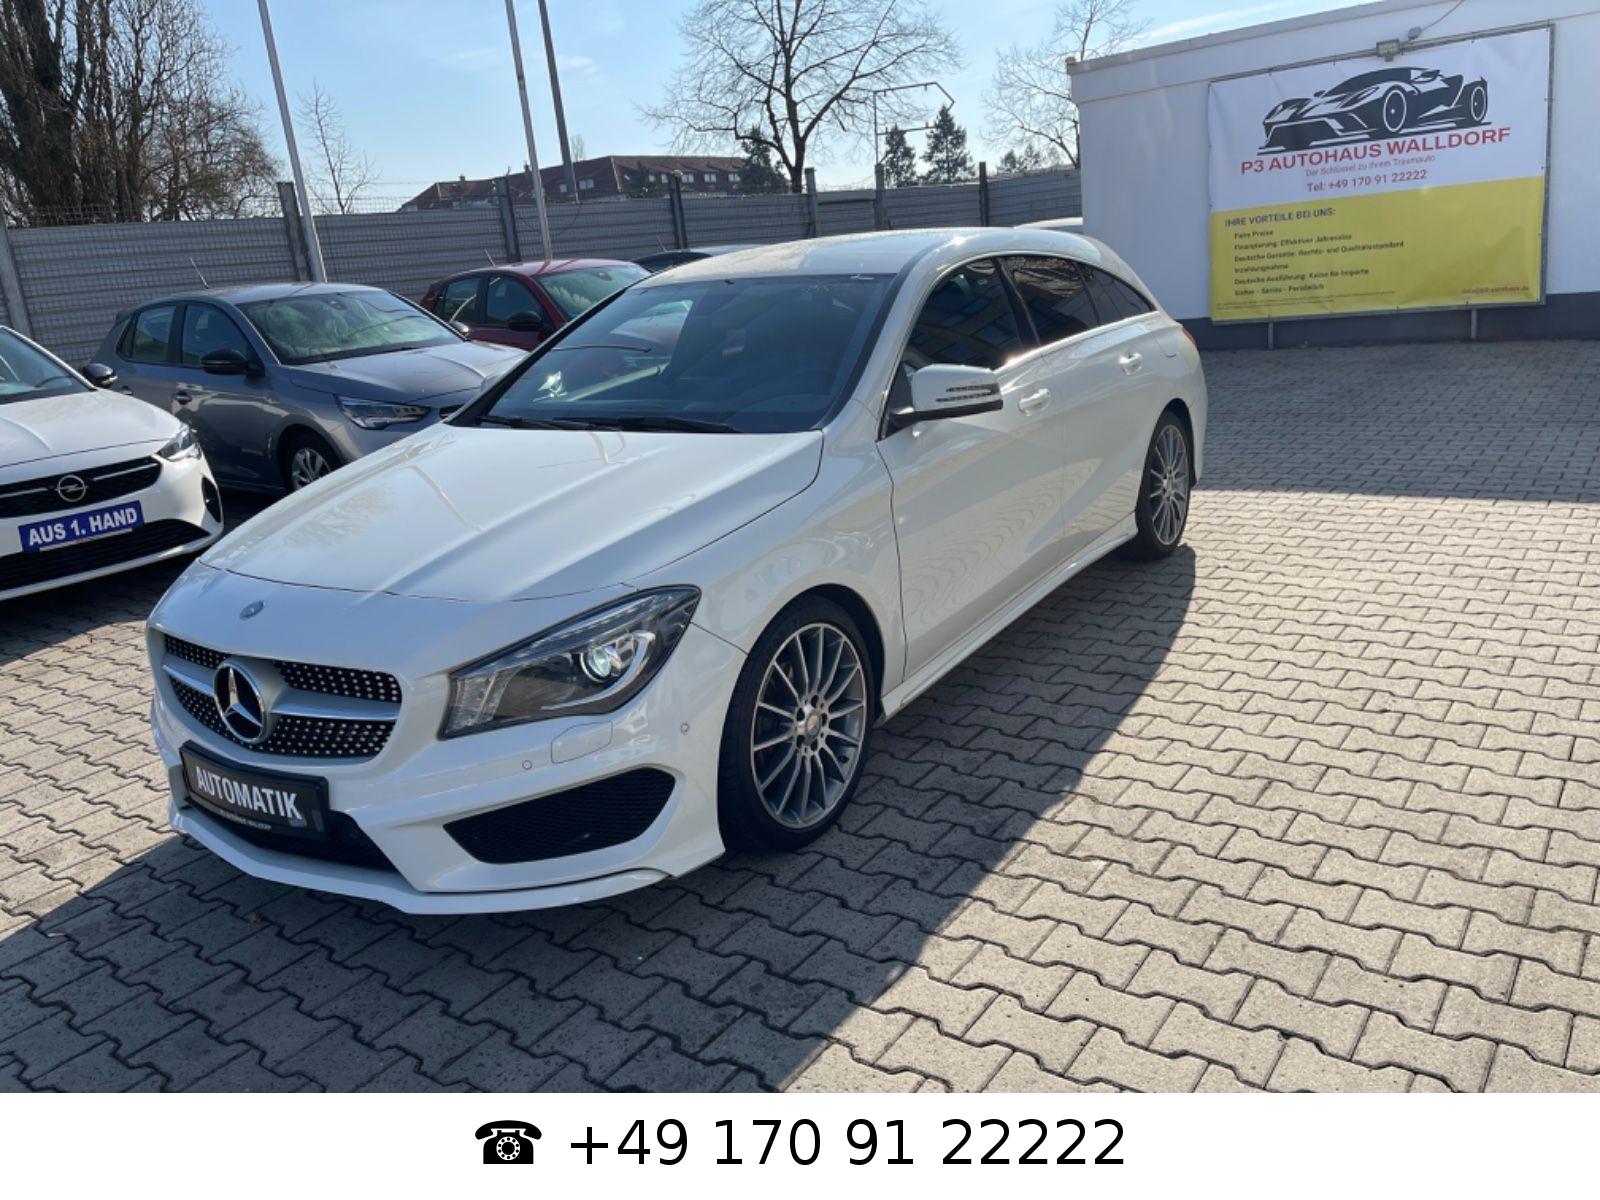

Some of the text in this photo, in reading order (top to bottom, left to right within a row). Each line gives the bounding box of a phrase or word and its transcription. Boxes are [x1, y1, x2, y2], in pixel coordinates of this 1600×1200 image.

[1241, 128, 1511, 175] P3 AUTOHAUS WALLDORF
[1357, 162, 1368, 172] zu
[1307, 170, 1427, 193] Tel: +49 170 91 22222
[1225, 208, 1336, 228] IHRE VORTEILE BEI UNS:
[29, 507, 137, 546] AUS 1. HAND
[195, 766, 303, 820] AUTOMATIK
